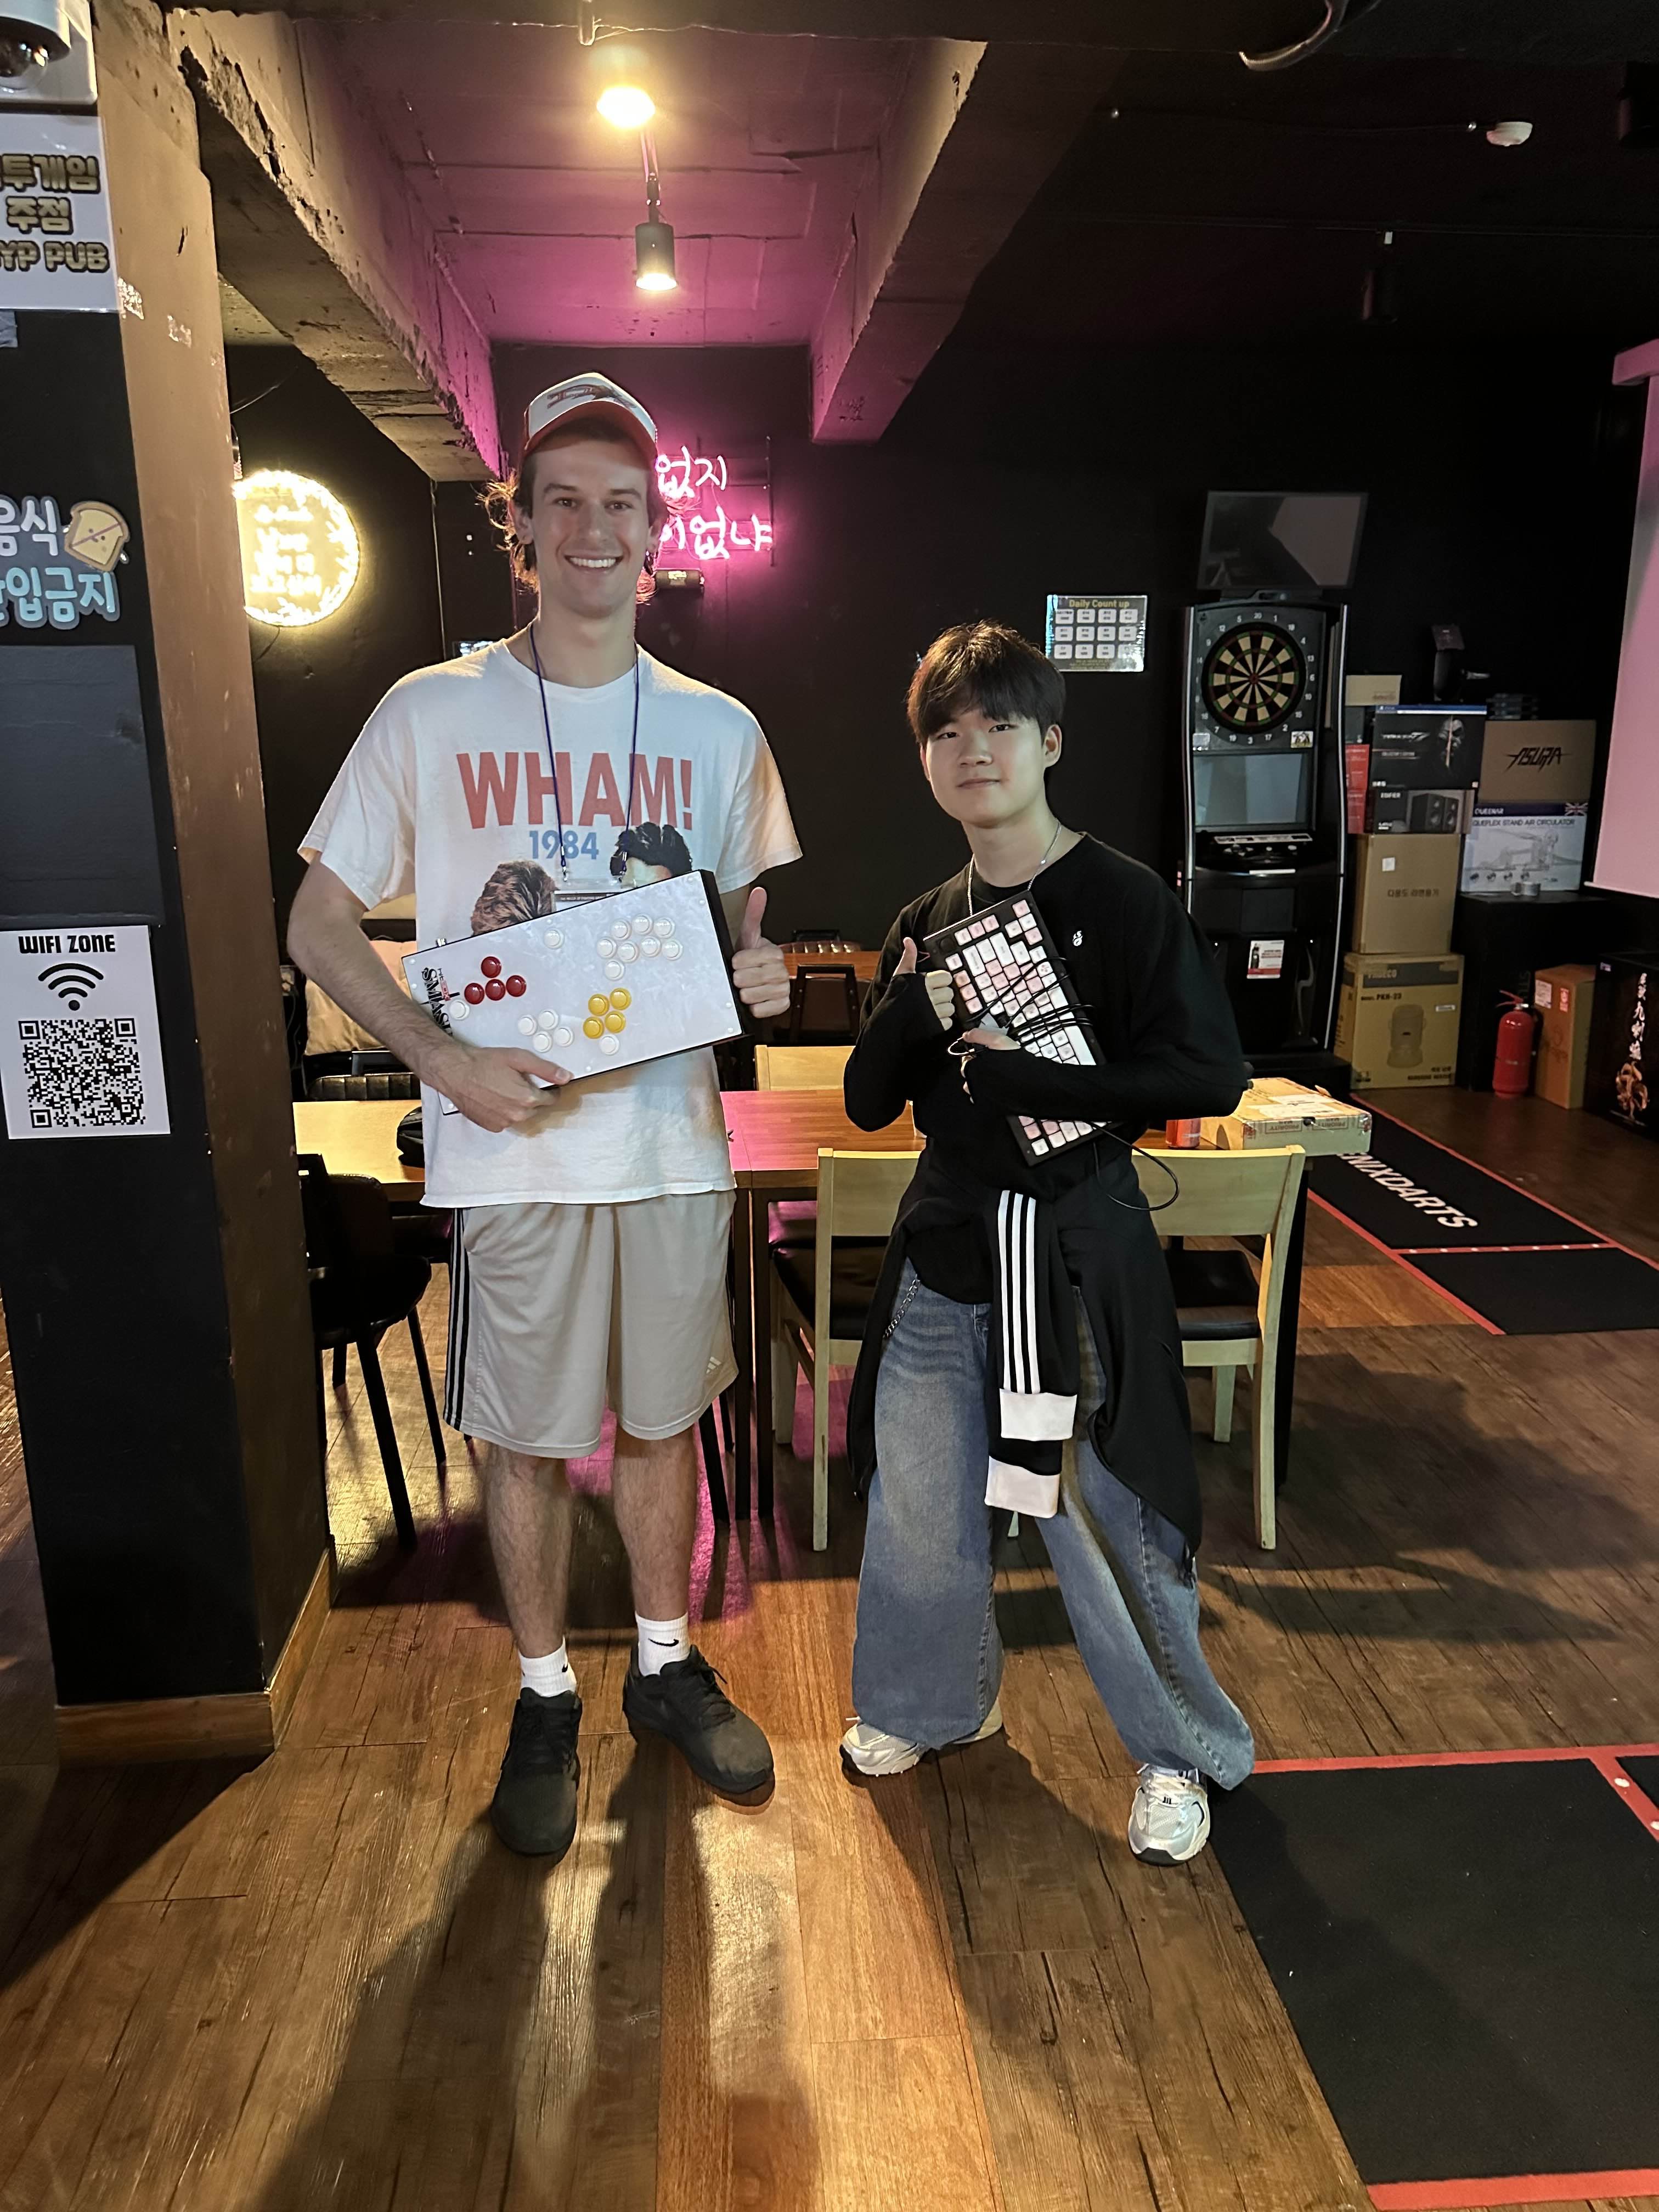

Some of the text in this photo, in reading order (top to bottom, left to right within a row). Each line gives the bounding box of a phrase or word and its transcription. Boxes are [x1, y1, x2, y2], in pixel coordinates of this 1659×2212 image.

[0, 153, 101, 194] 투게임
[5, 196, 74, 235] 주점
[0, 240, 110, 273] YP PUB
[0, 499, 58, 556] 음식
[1069, 600, 1090, 608] Daily
[1119, 601, 1130, 609] up
[456, 752, 693, 831] WHAM!
[528, 830, 600, 860] 1984
[18, 934, 116, 954] WIFI ZONE
